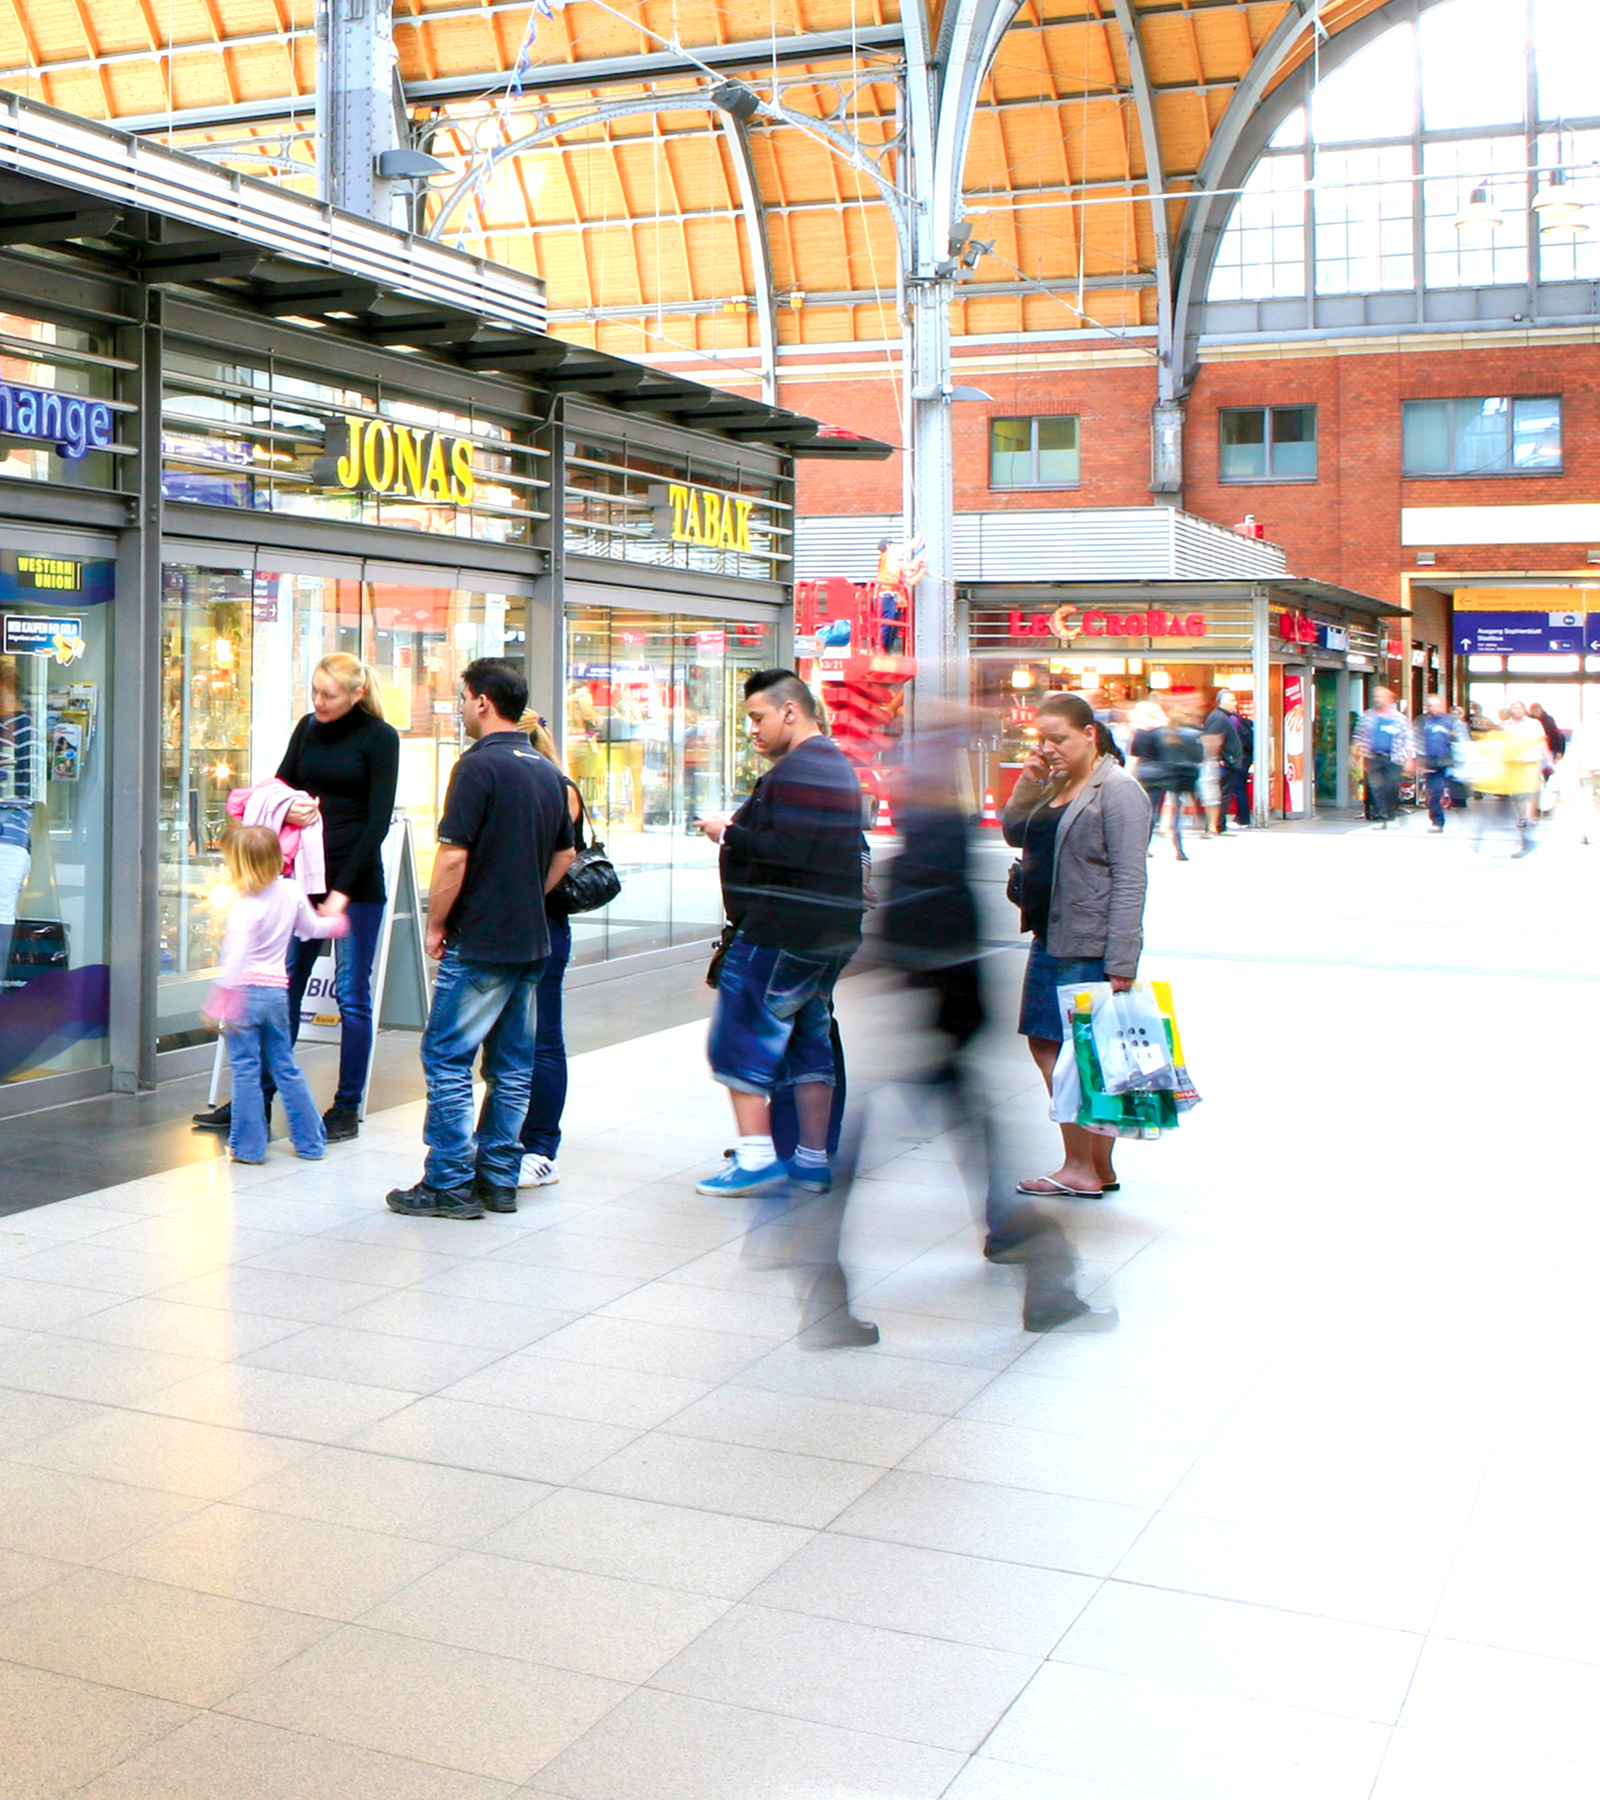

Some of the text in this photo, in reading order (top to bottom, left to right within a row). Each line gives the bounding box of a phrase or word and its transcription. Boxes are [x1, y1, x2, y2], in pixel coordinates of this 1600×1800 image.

[337, 416, 474, 507] JONAS
[668, 484, 753, 552] TABAK
[17, 556, 72, 575] WESTERN
[34, 573, 72, 590] UNION
